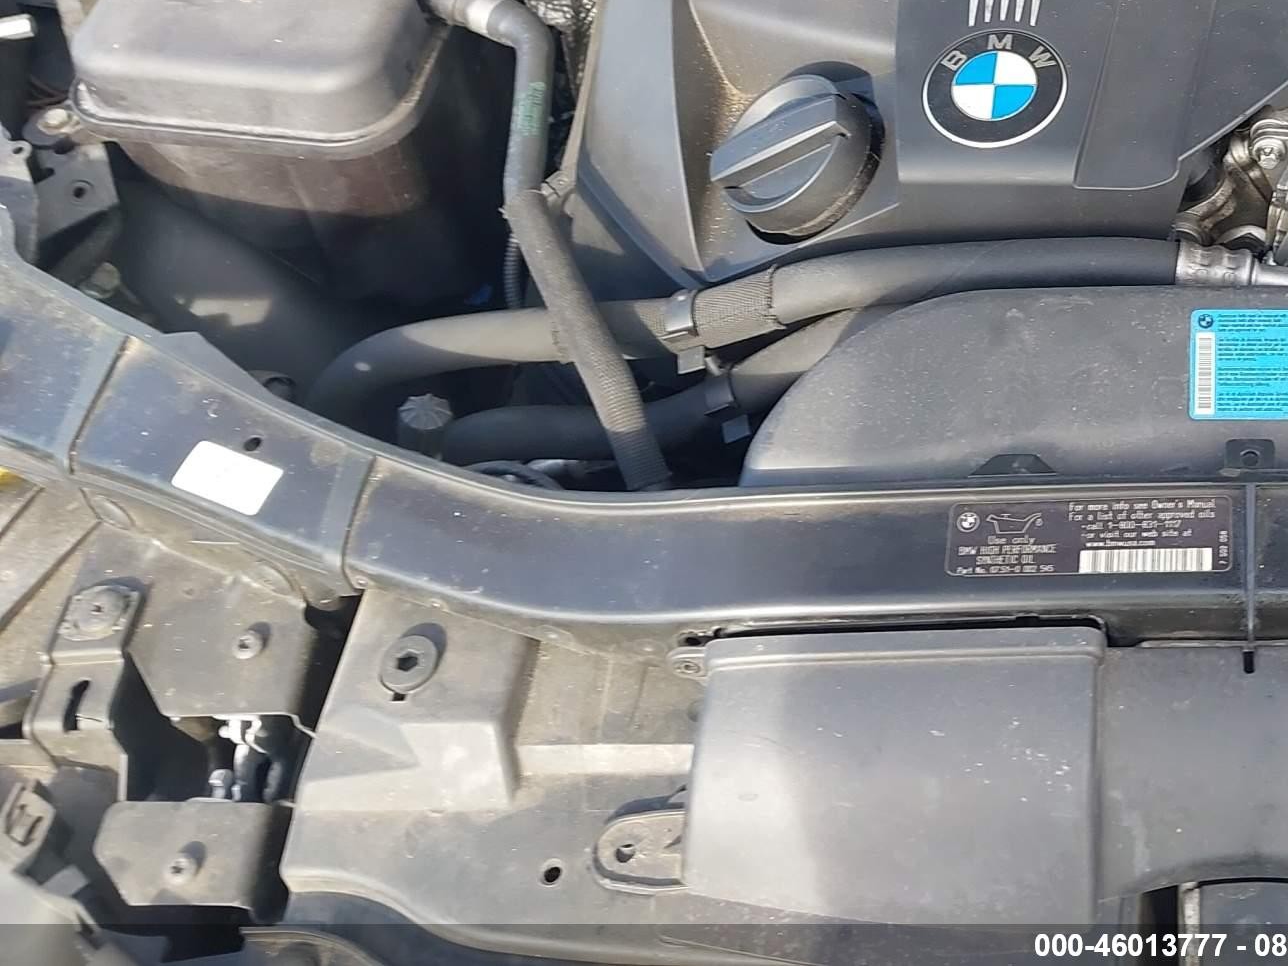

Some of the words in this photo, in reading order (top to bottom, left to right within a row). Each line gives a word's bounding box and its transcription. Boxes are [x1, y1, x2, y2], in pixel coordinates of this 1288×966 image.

[940, 34, 1059, 71] BMW
[1069, 502, 1084, 511] For
[1112, 502, 1130, 511] info
[1151, 500, 1183, 509] Owner's
[1186, 499, 1216, 509] Manual
[1069, 512, 1083, 521] For
[1097, 511, 1113, 520] list
[1116, 511, 1127, 520] of
[1130, 511, 1153, 520] other
[1157, 509, 1195, 520] approved
[1198, 509, 1216, 518] oils
[1099, 530, 1120, 538] visit
[1161, 529, 1179, 537] site
[1182, 529, 1193, 537] at
[987, 535, 1007, 544] Use
[1011, 534, 1036, 545] only
[958, 545, 978, 555] BMW
[975, 555, 1019, 565] SYNTHETIC
[1021, 554, 1037, 563] OIL
[956, 566, 973, 574] Part
